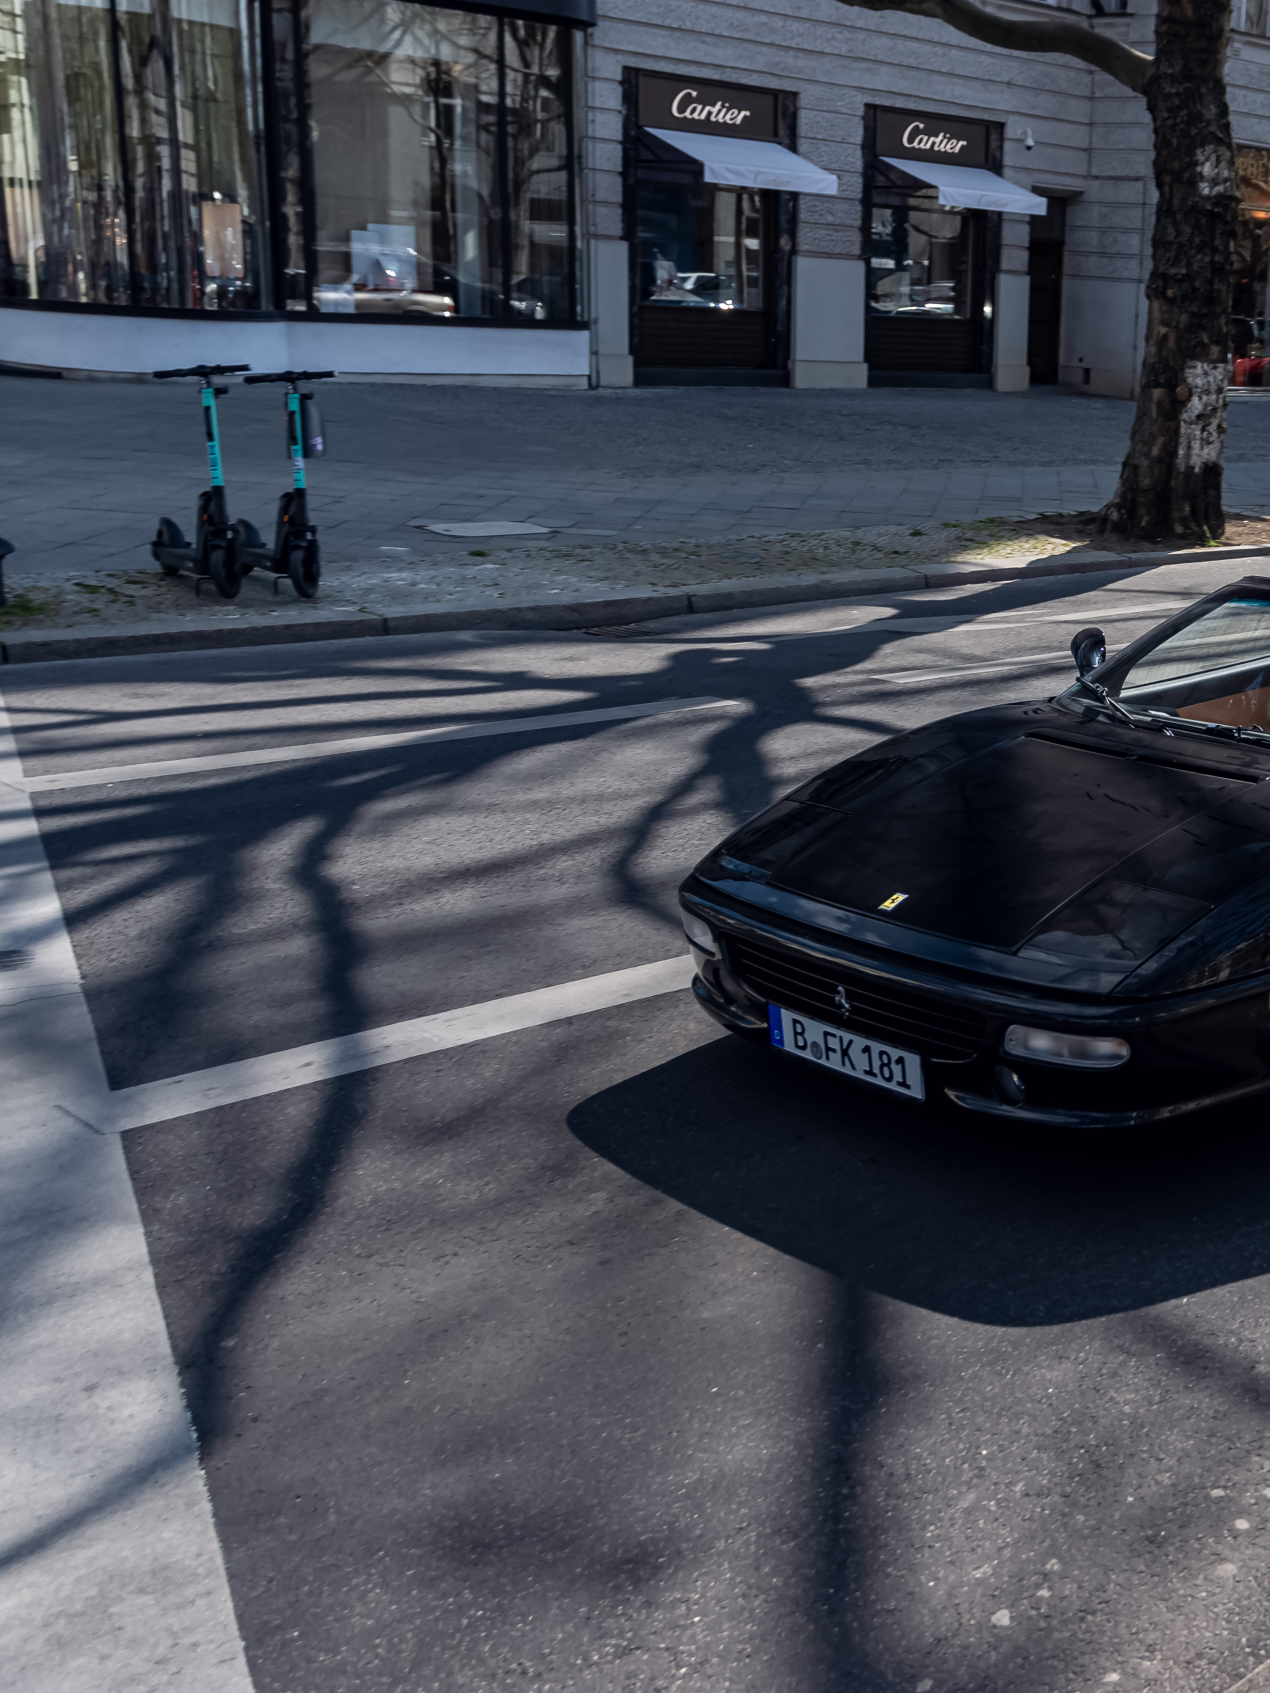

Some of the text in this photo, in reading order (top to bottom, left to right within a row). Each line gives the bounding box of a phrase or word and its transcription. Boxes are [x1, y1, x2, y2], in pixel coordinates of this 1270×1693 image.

[671, 88, 750, 125] Cartier
[901, 121, 967, 154] Cartier
[792, 1017, 911, 1090] B FK 181
